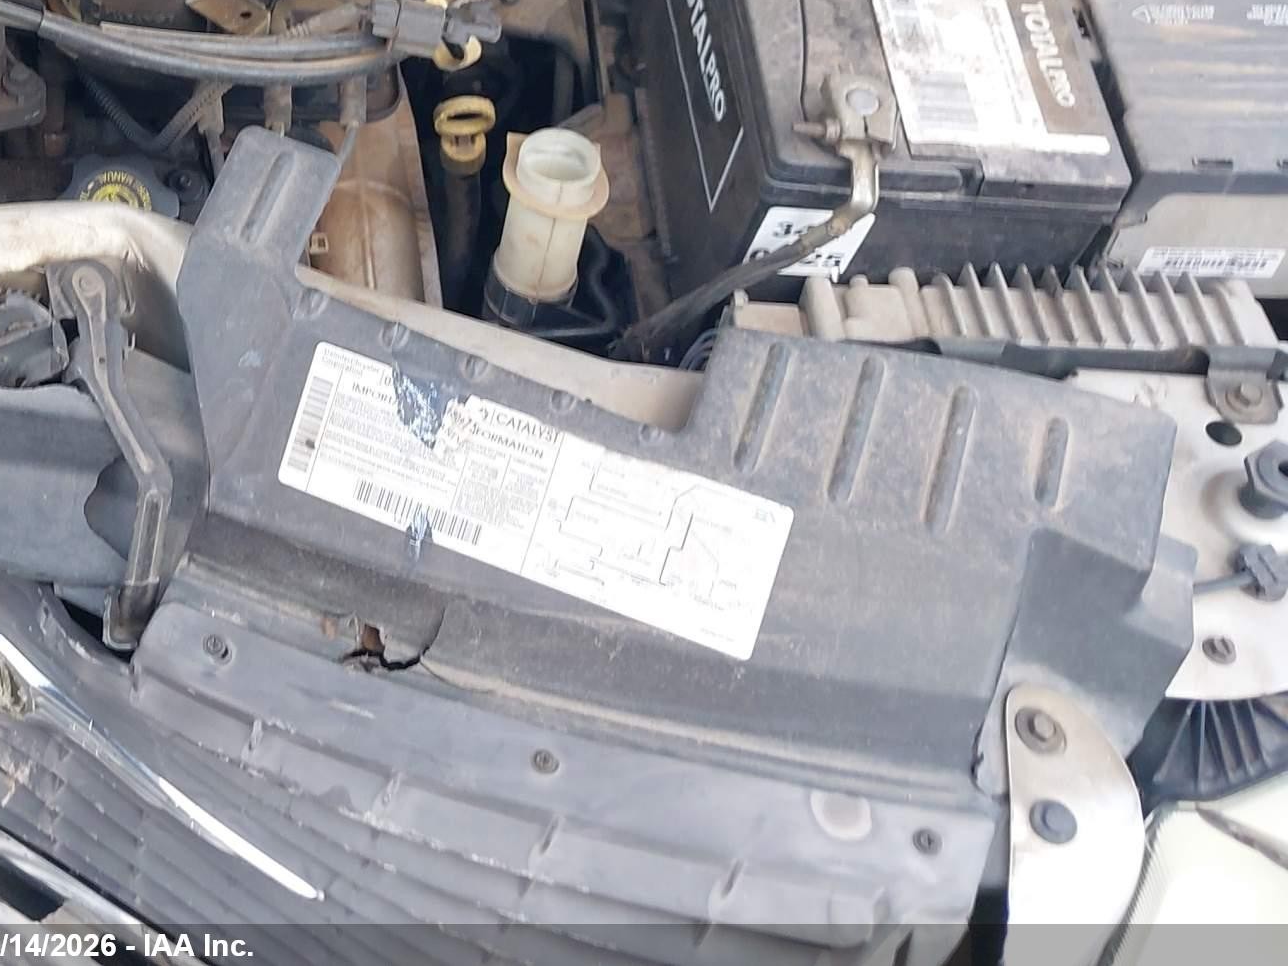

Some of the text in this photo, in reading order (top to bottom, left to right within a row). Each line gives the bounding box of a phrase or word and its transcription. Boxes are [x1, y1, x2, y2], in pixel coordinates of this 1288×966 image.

[1020, 1, 1075, 108] TOTALPRO
[470, 422, 544, 459] NFORMATION
[496, 413, 560, 443] CATALYST
